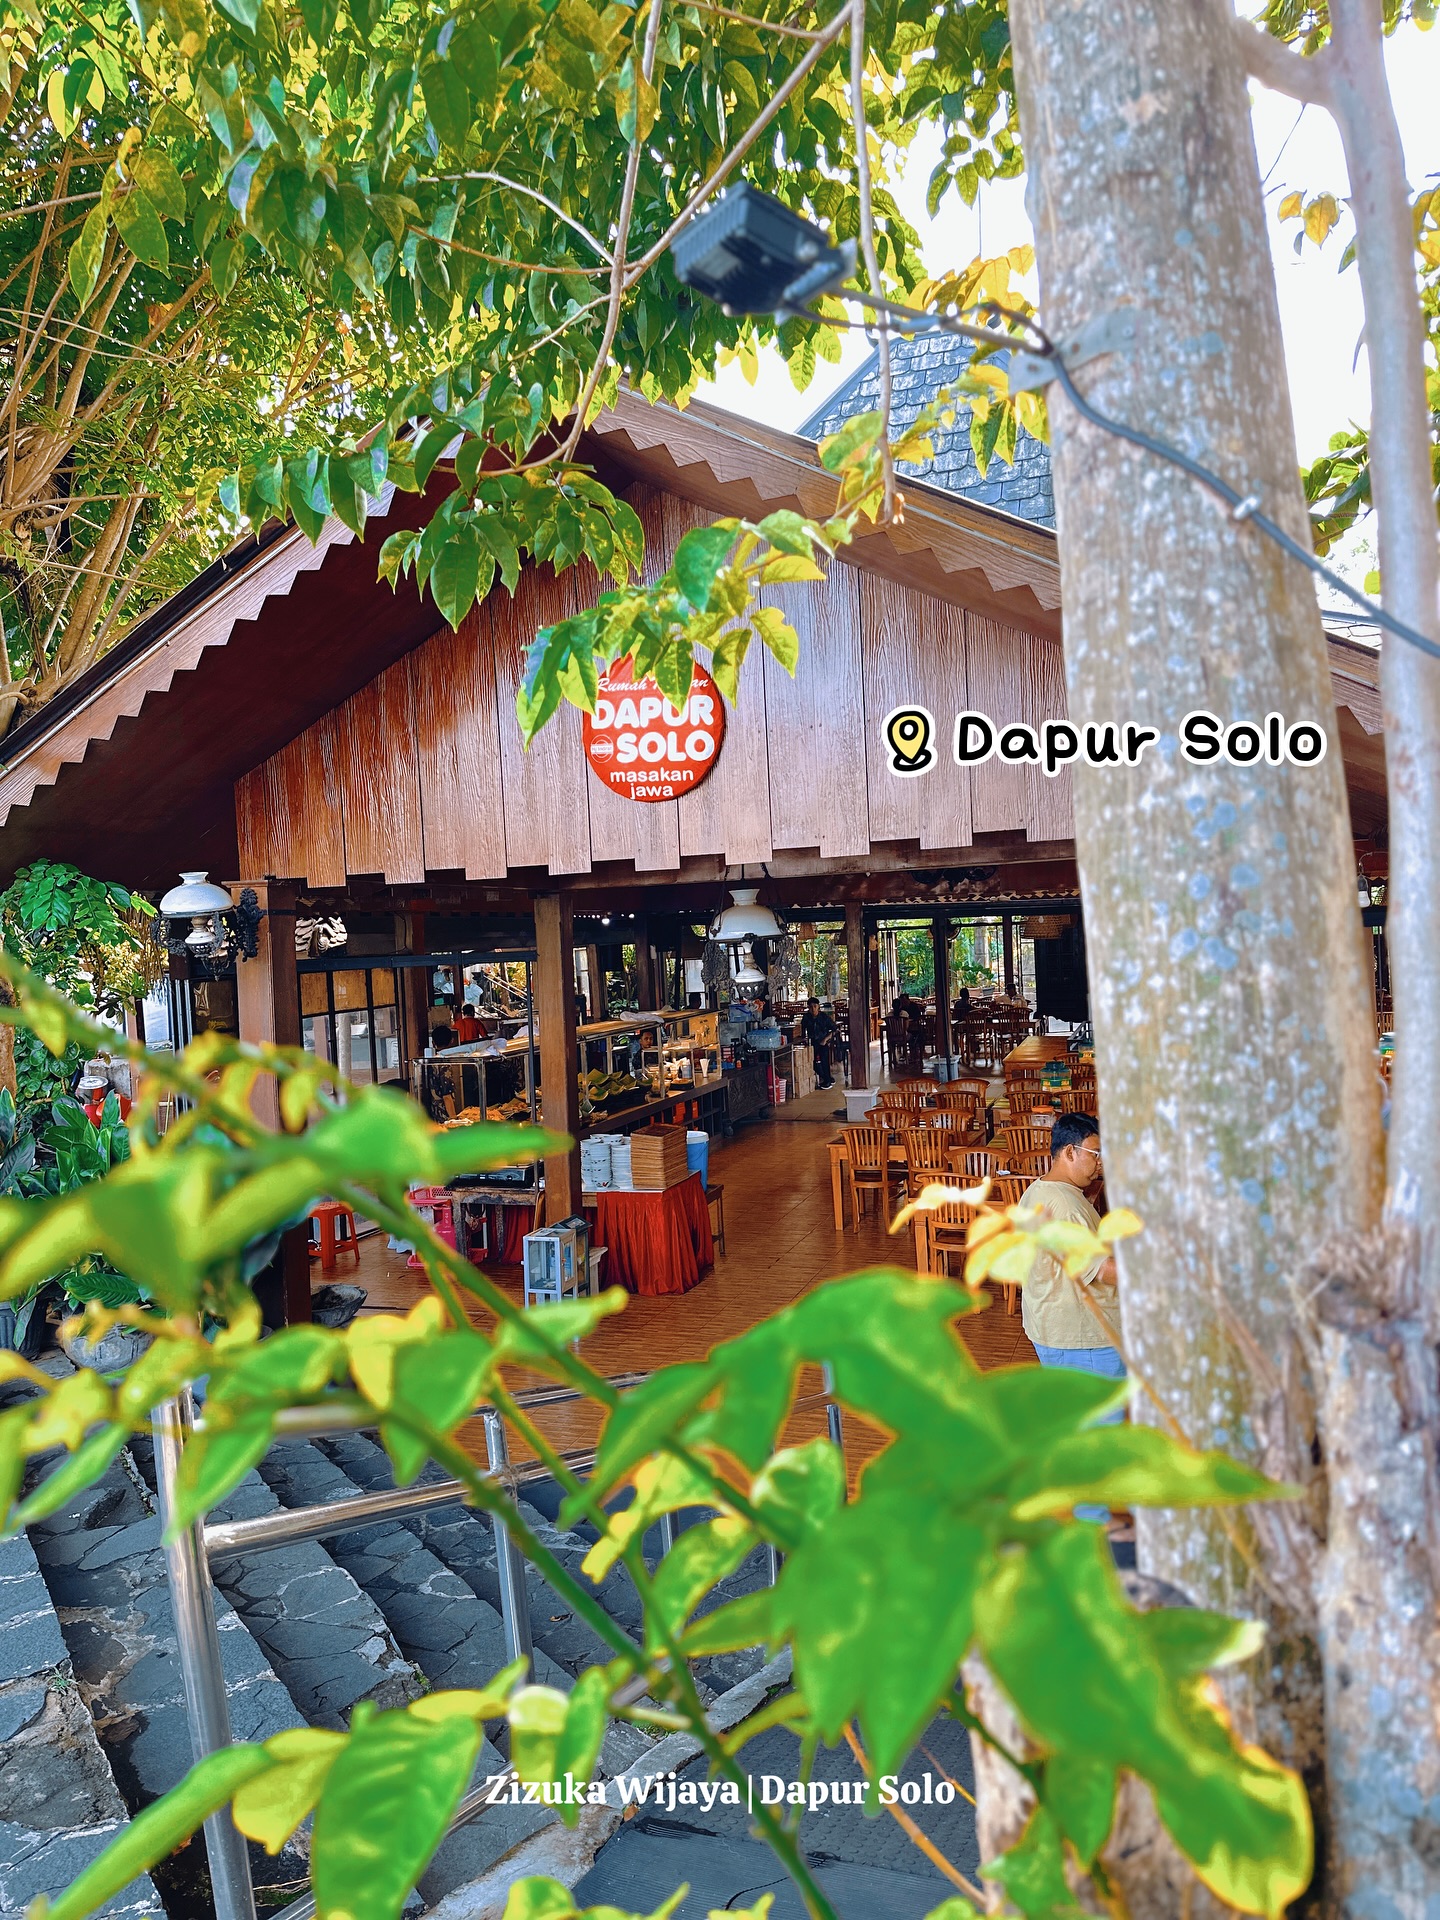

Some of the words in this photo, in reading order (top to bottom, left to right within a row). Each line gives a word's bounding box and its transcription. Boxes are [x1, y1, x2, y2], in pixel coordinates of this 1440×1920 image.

[598, 676, 647, 692] Rumah
[591, 695, 714, 729] DAPUR
[616, 730, 715, 763] SOLO
[610, 767, 694, 782] masakan
[630, 783, 673, 799] jawa
